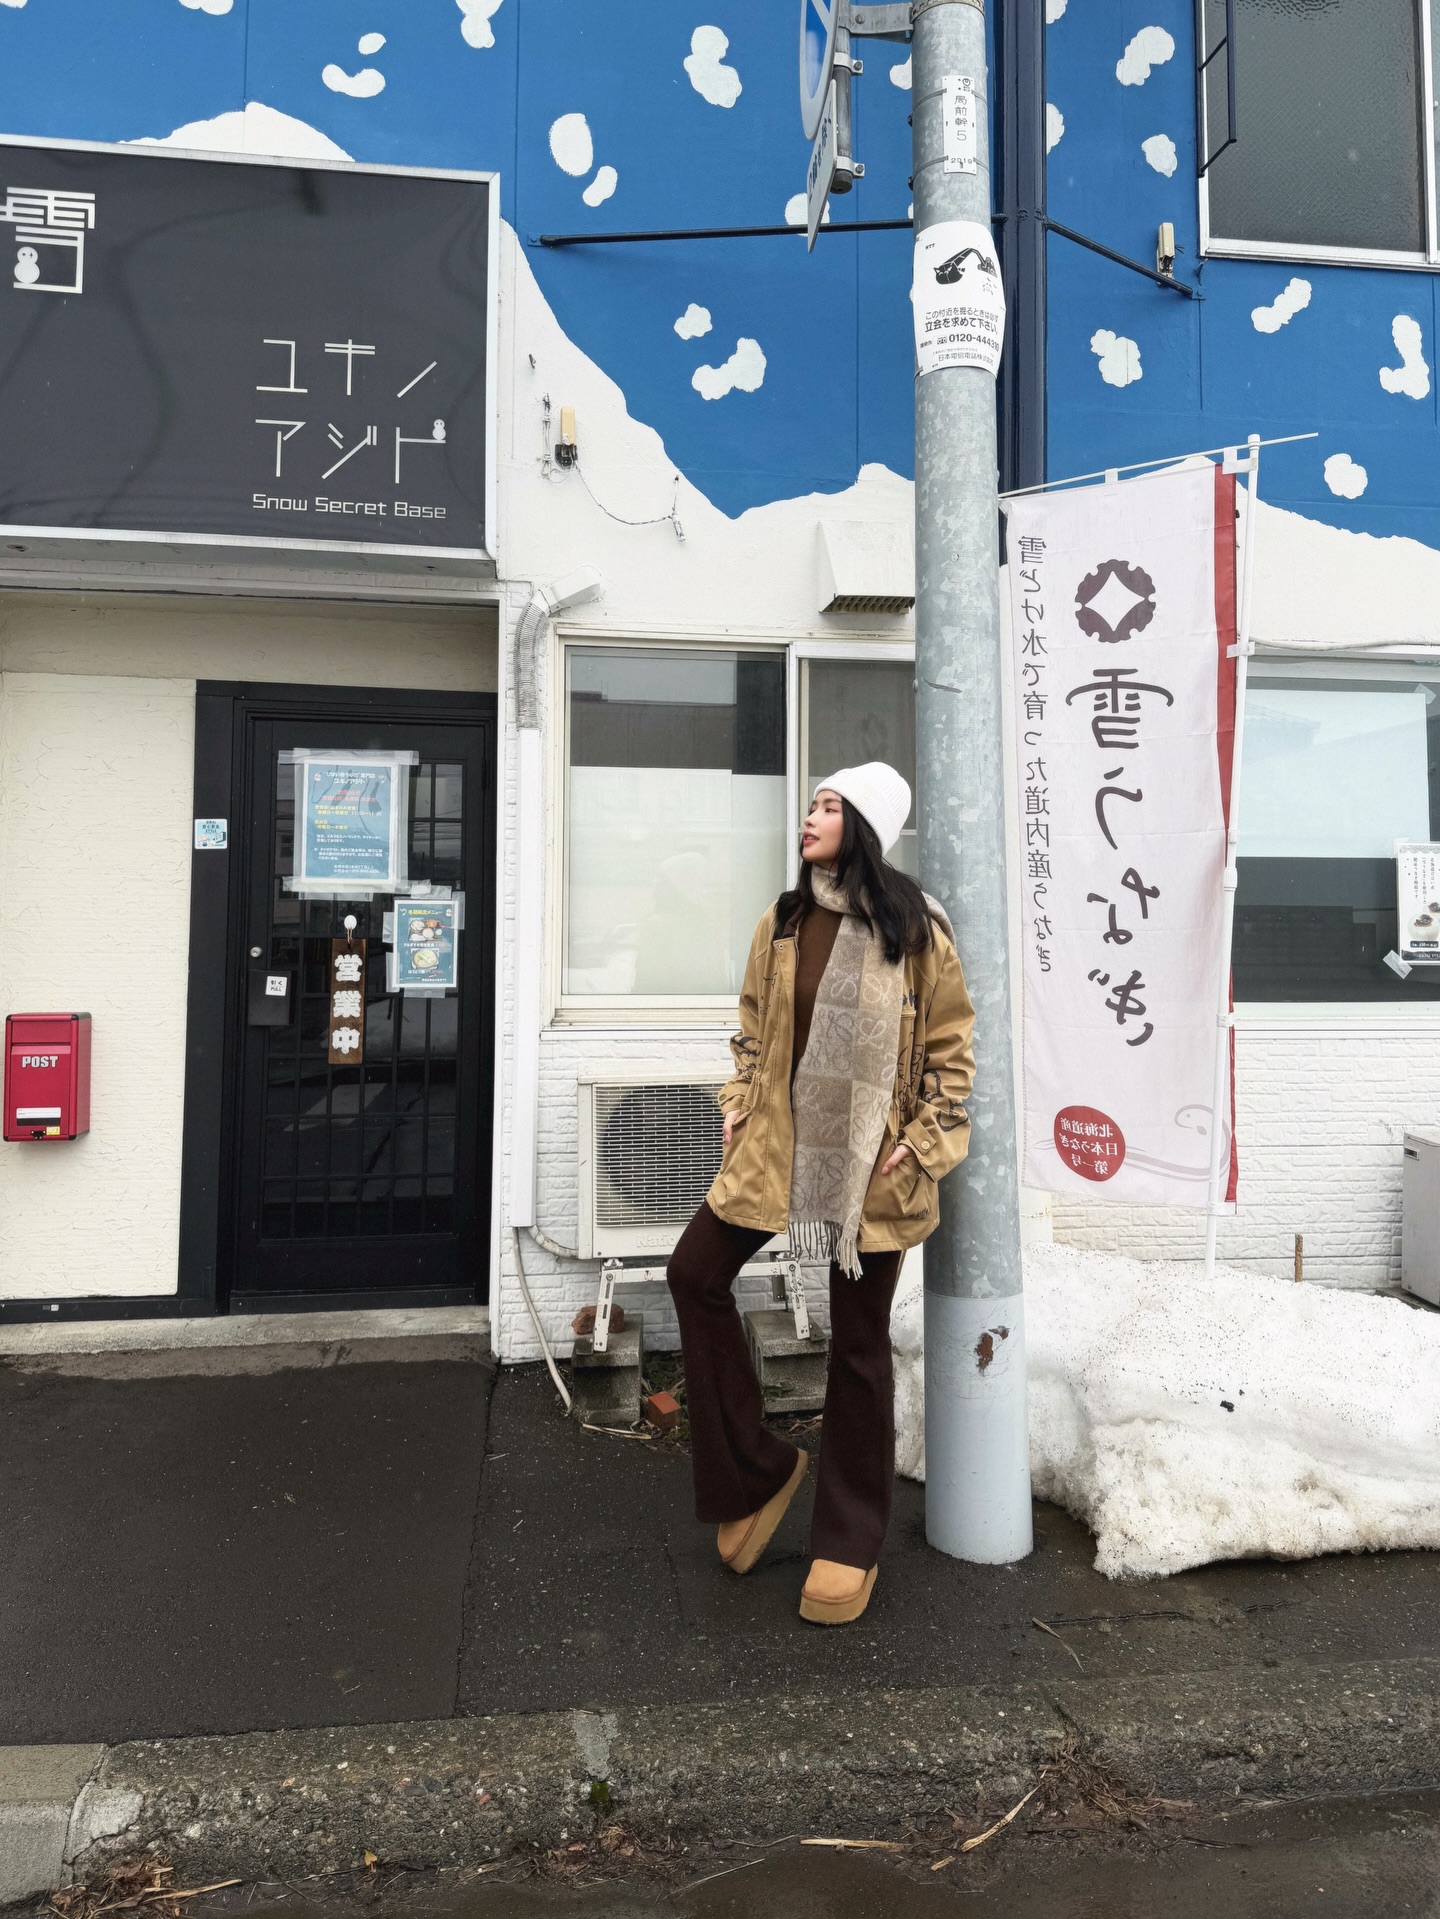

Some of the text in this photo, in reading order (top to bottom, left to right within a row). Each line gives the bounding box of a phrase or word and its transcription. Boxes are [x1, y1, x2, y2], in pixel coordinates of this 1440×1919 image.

[256, 339, 437, 398] ユキノ
[253, 494, 446, 519] Snow Secret Base
[332, 954, 362, 1054] 営業中
[22, 1055, 59, 1068] POST
